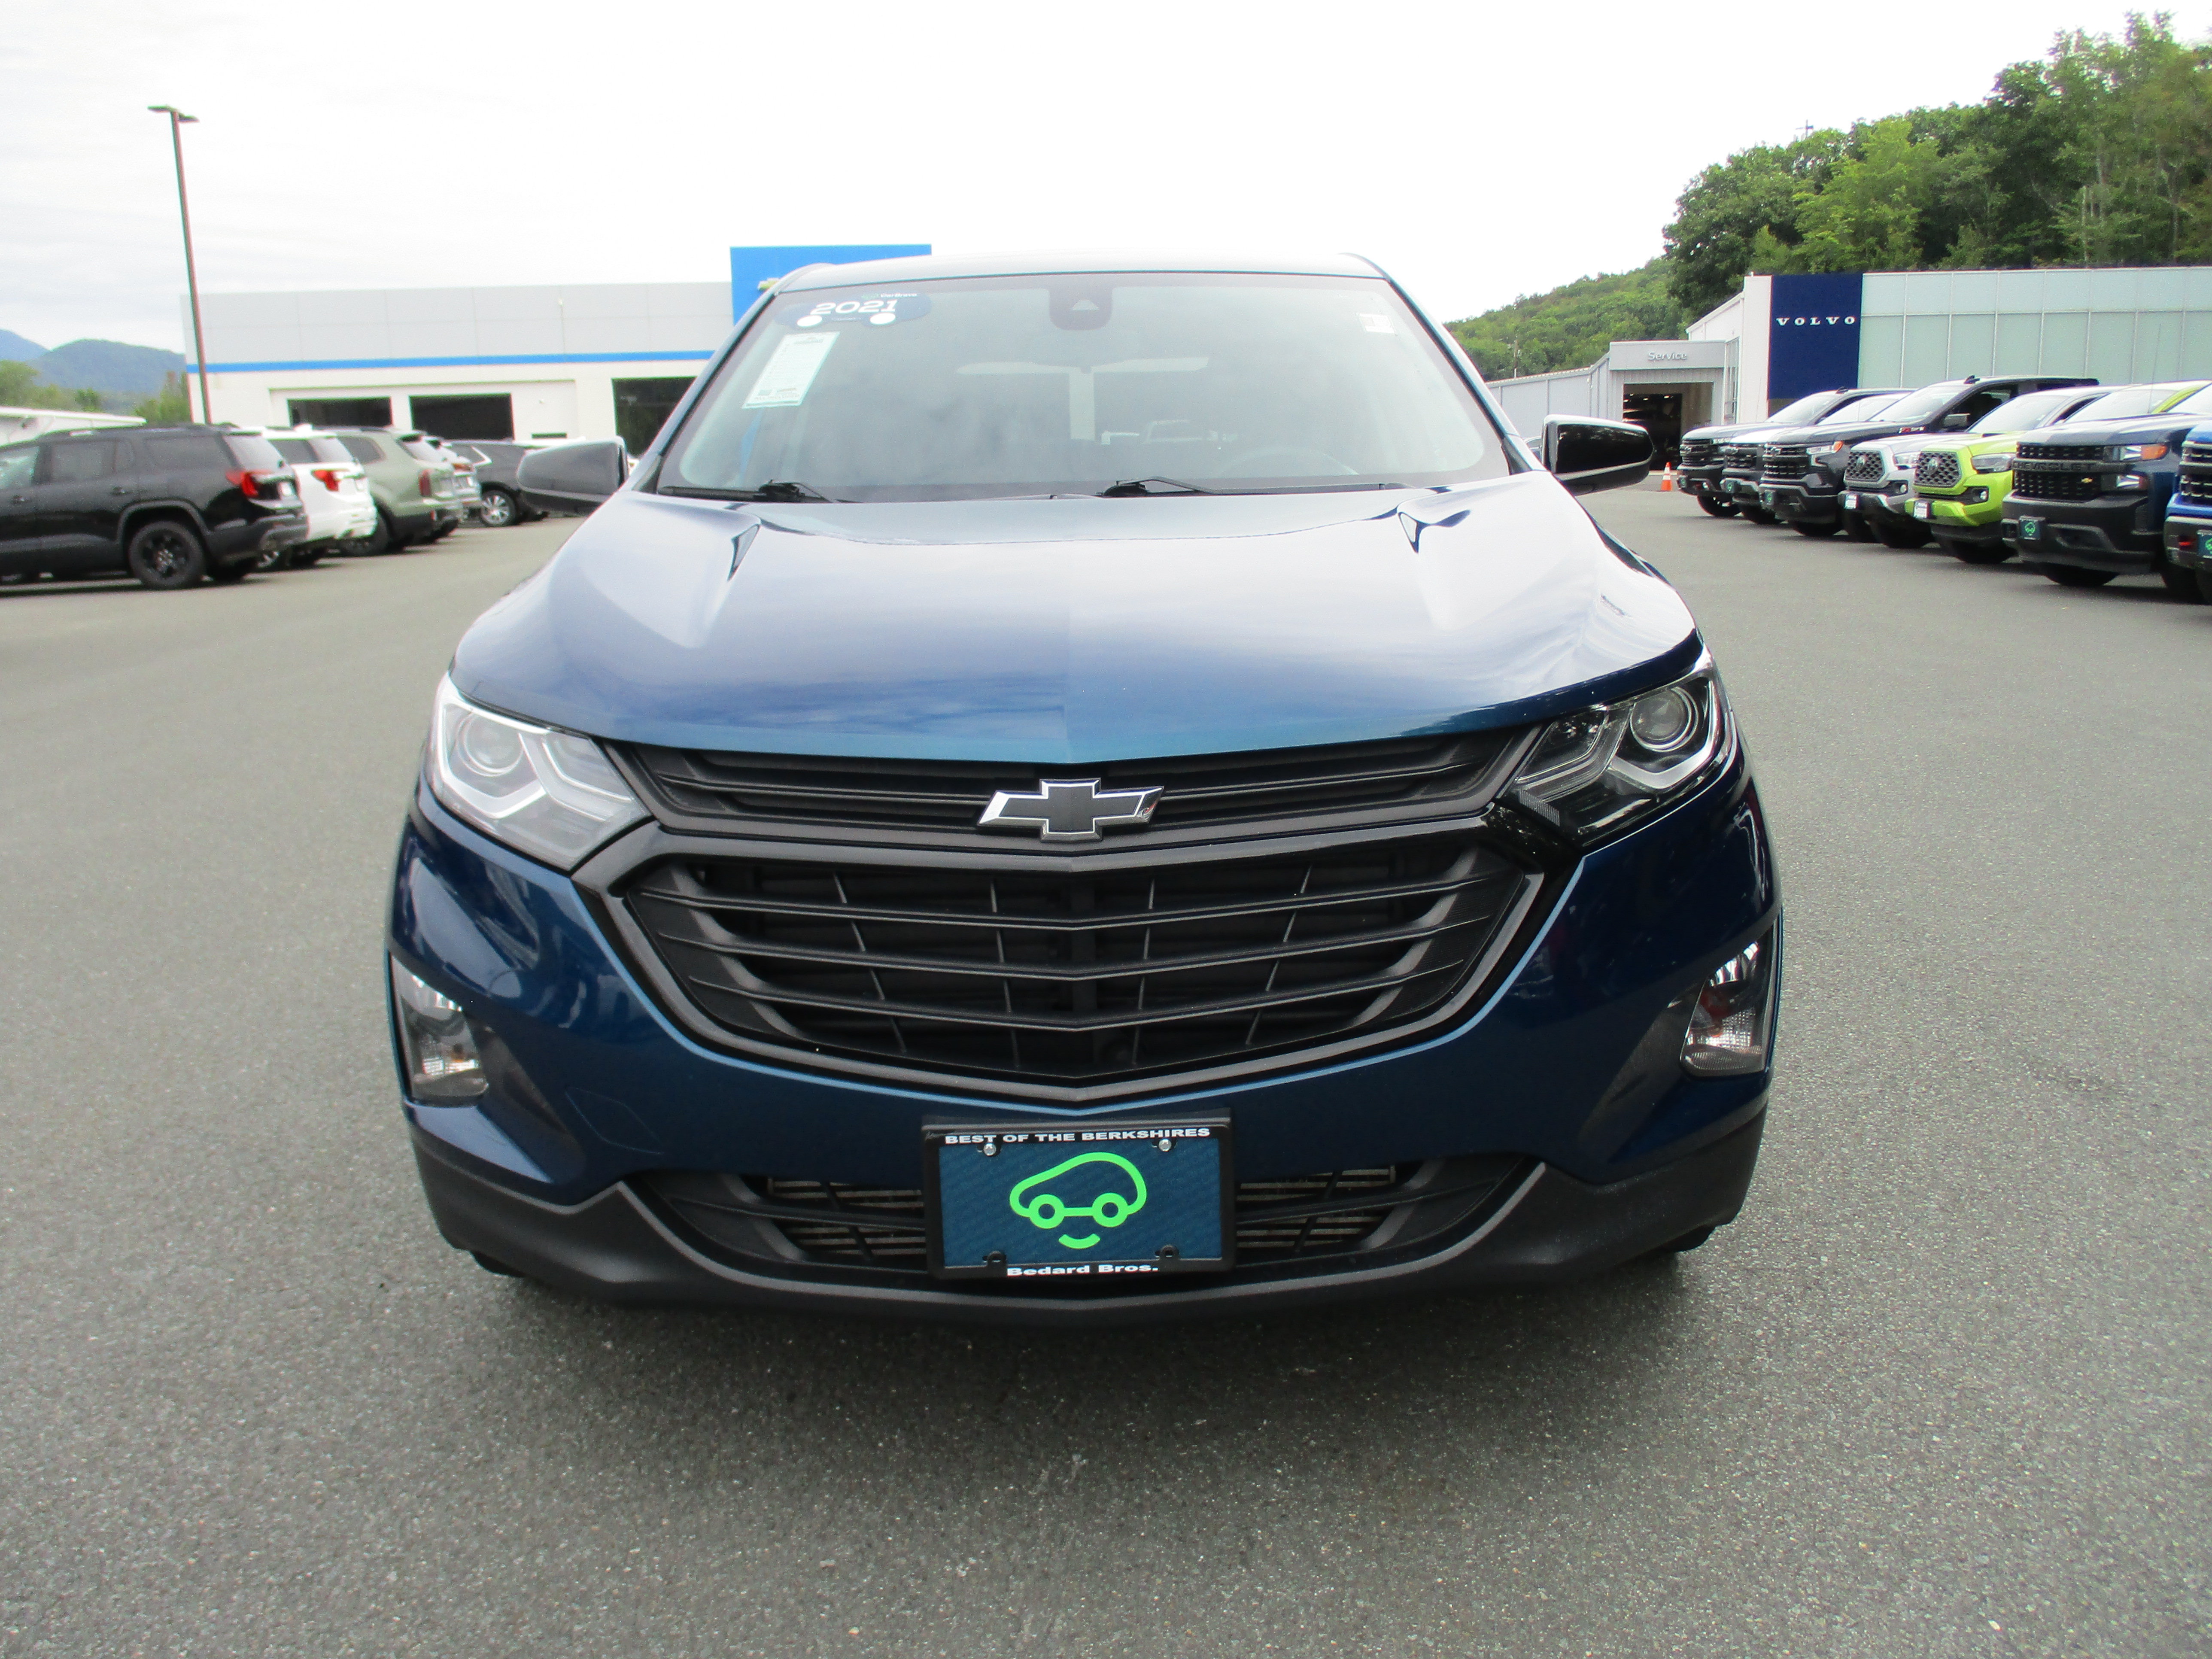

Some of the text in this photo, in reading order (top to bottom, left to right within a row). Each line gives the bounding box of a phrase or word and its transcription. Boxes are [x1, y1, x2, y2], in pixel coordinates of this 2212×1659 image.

[810, 299, 897, 315] 2021
[1776, 316, 1856, 326] VOLVO
[1648, 351, 1687, 360] Service
[945, 1128, 1210, 1145] BEST OF THE BERKSHIRES
[1007, 1264, 1159, 1277] Bedard Bros.
